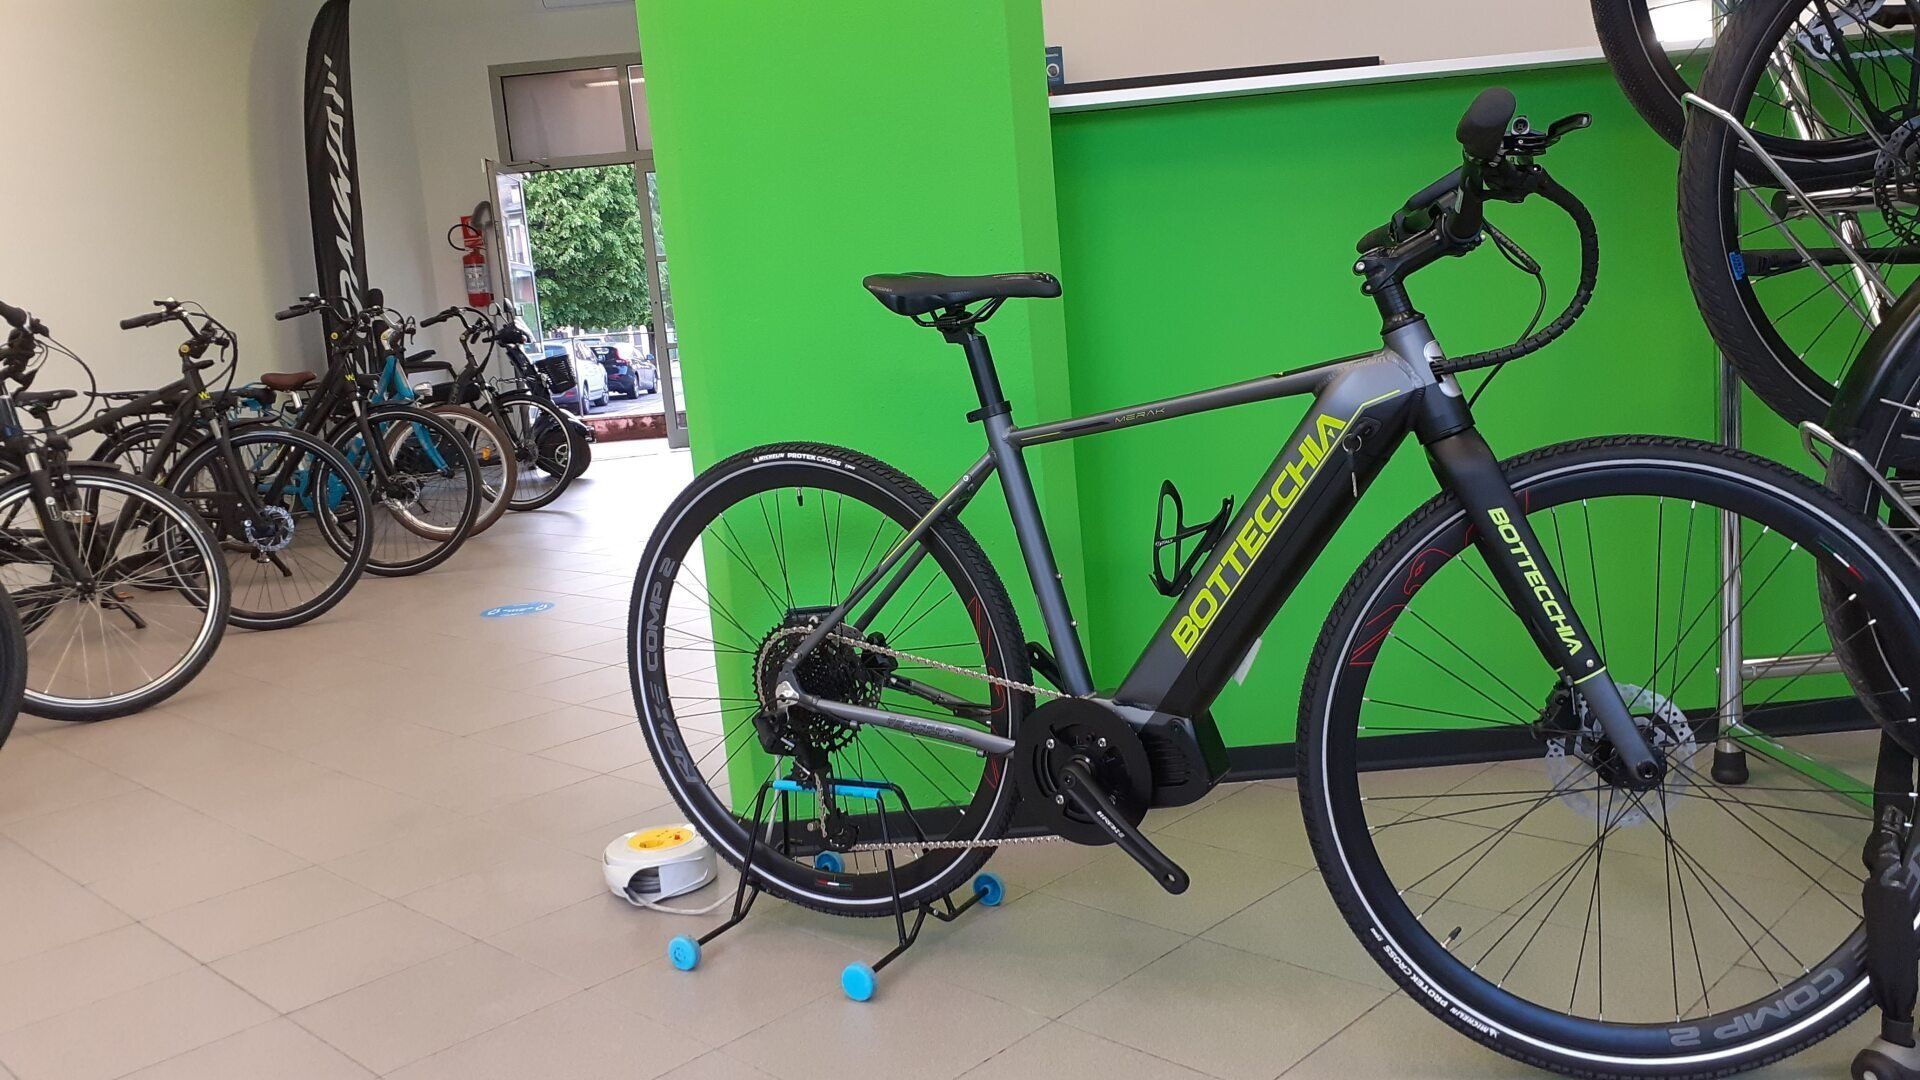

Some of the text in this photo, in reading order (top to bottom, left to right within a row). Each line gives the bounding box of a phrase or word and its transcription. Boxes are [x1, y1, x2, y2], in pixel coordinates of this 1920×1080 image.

[787, 452, 817, 461] PROTEK
[816, 456, 842, 467] CROSS
[1114, 408, 1166, 424] MERAK
[1171, 413, 1347, 657] BOTTECCHIA
[646, 581, 664, 672] COMP
[659, 556, 676, 579] 2
[1487, 507, 1583, 657] BOTTECCHIA
[1382, 944, 1491, 1034] MICHELIN PROTEK CROSS
[1668, 967, 1845, 1047] COMP 2
